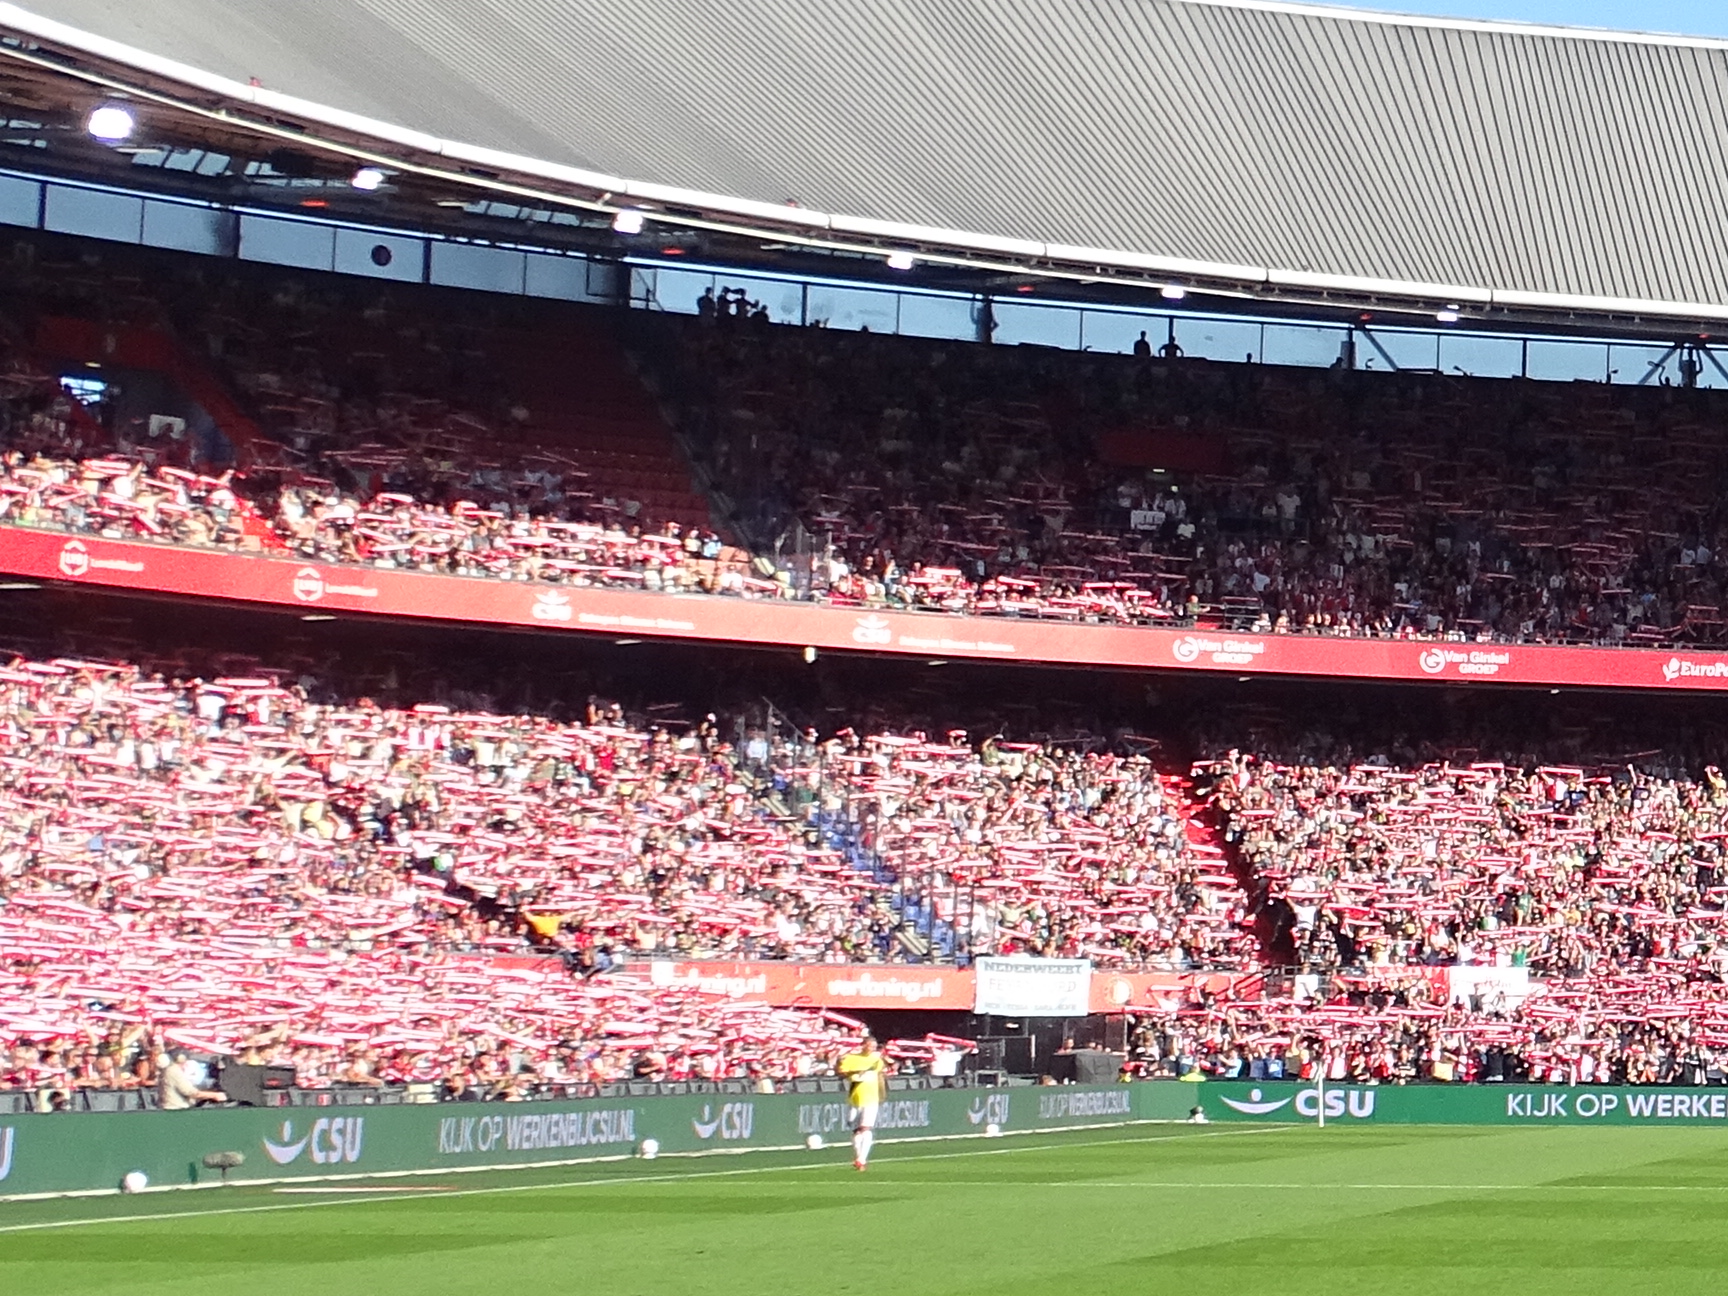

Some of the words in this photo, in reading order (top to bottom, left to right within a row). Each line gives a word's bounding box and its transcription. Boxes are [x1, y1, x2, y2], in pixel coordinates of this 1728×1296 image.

[1199, 639, 1221, 652] Van
[1223, 639, 1264, 654] Ginkel
[1445, 650, 1468, 664] Van
[1469, 651, 1510, 665] Ginkel
[1459, 664, 1499, 675] GROEP
[1295, 1088, 1375, 1118] CSU
[1507, 1093, 1568, 1118] KIJK
[1576, 1093, 1618, 1118] OP
[439, 1116, 474, 1153] KIJK
[478, 1115, 502, 1152] OP
[507, 1109, 636, 1151] WERKENBIJCSU.NL
[721, 1102, 754, 1140] CSU
[312, 1116, 364, 1164] CSU
